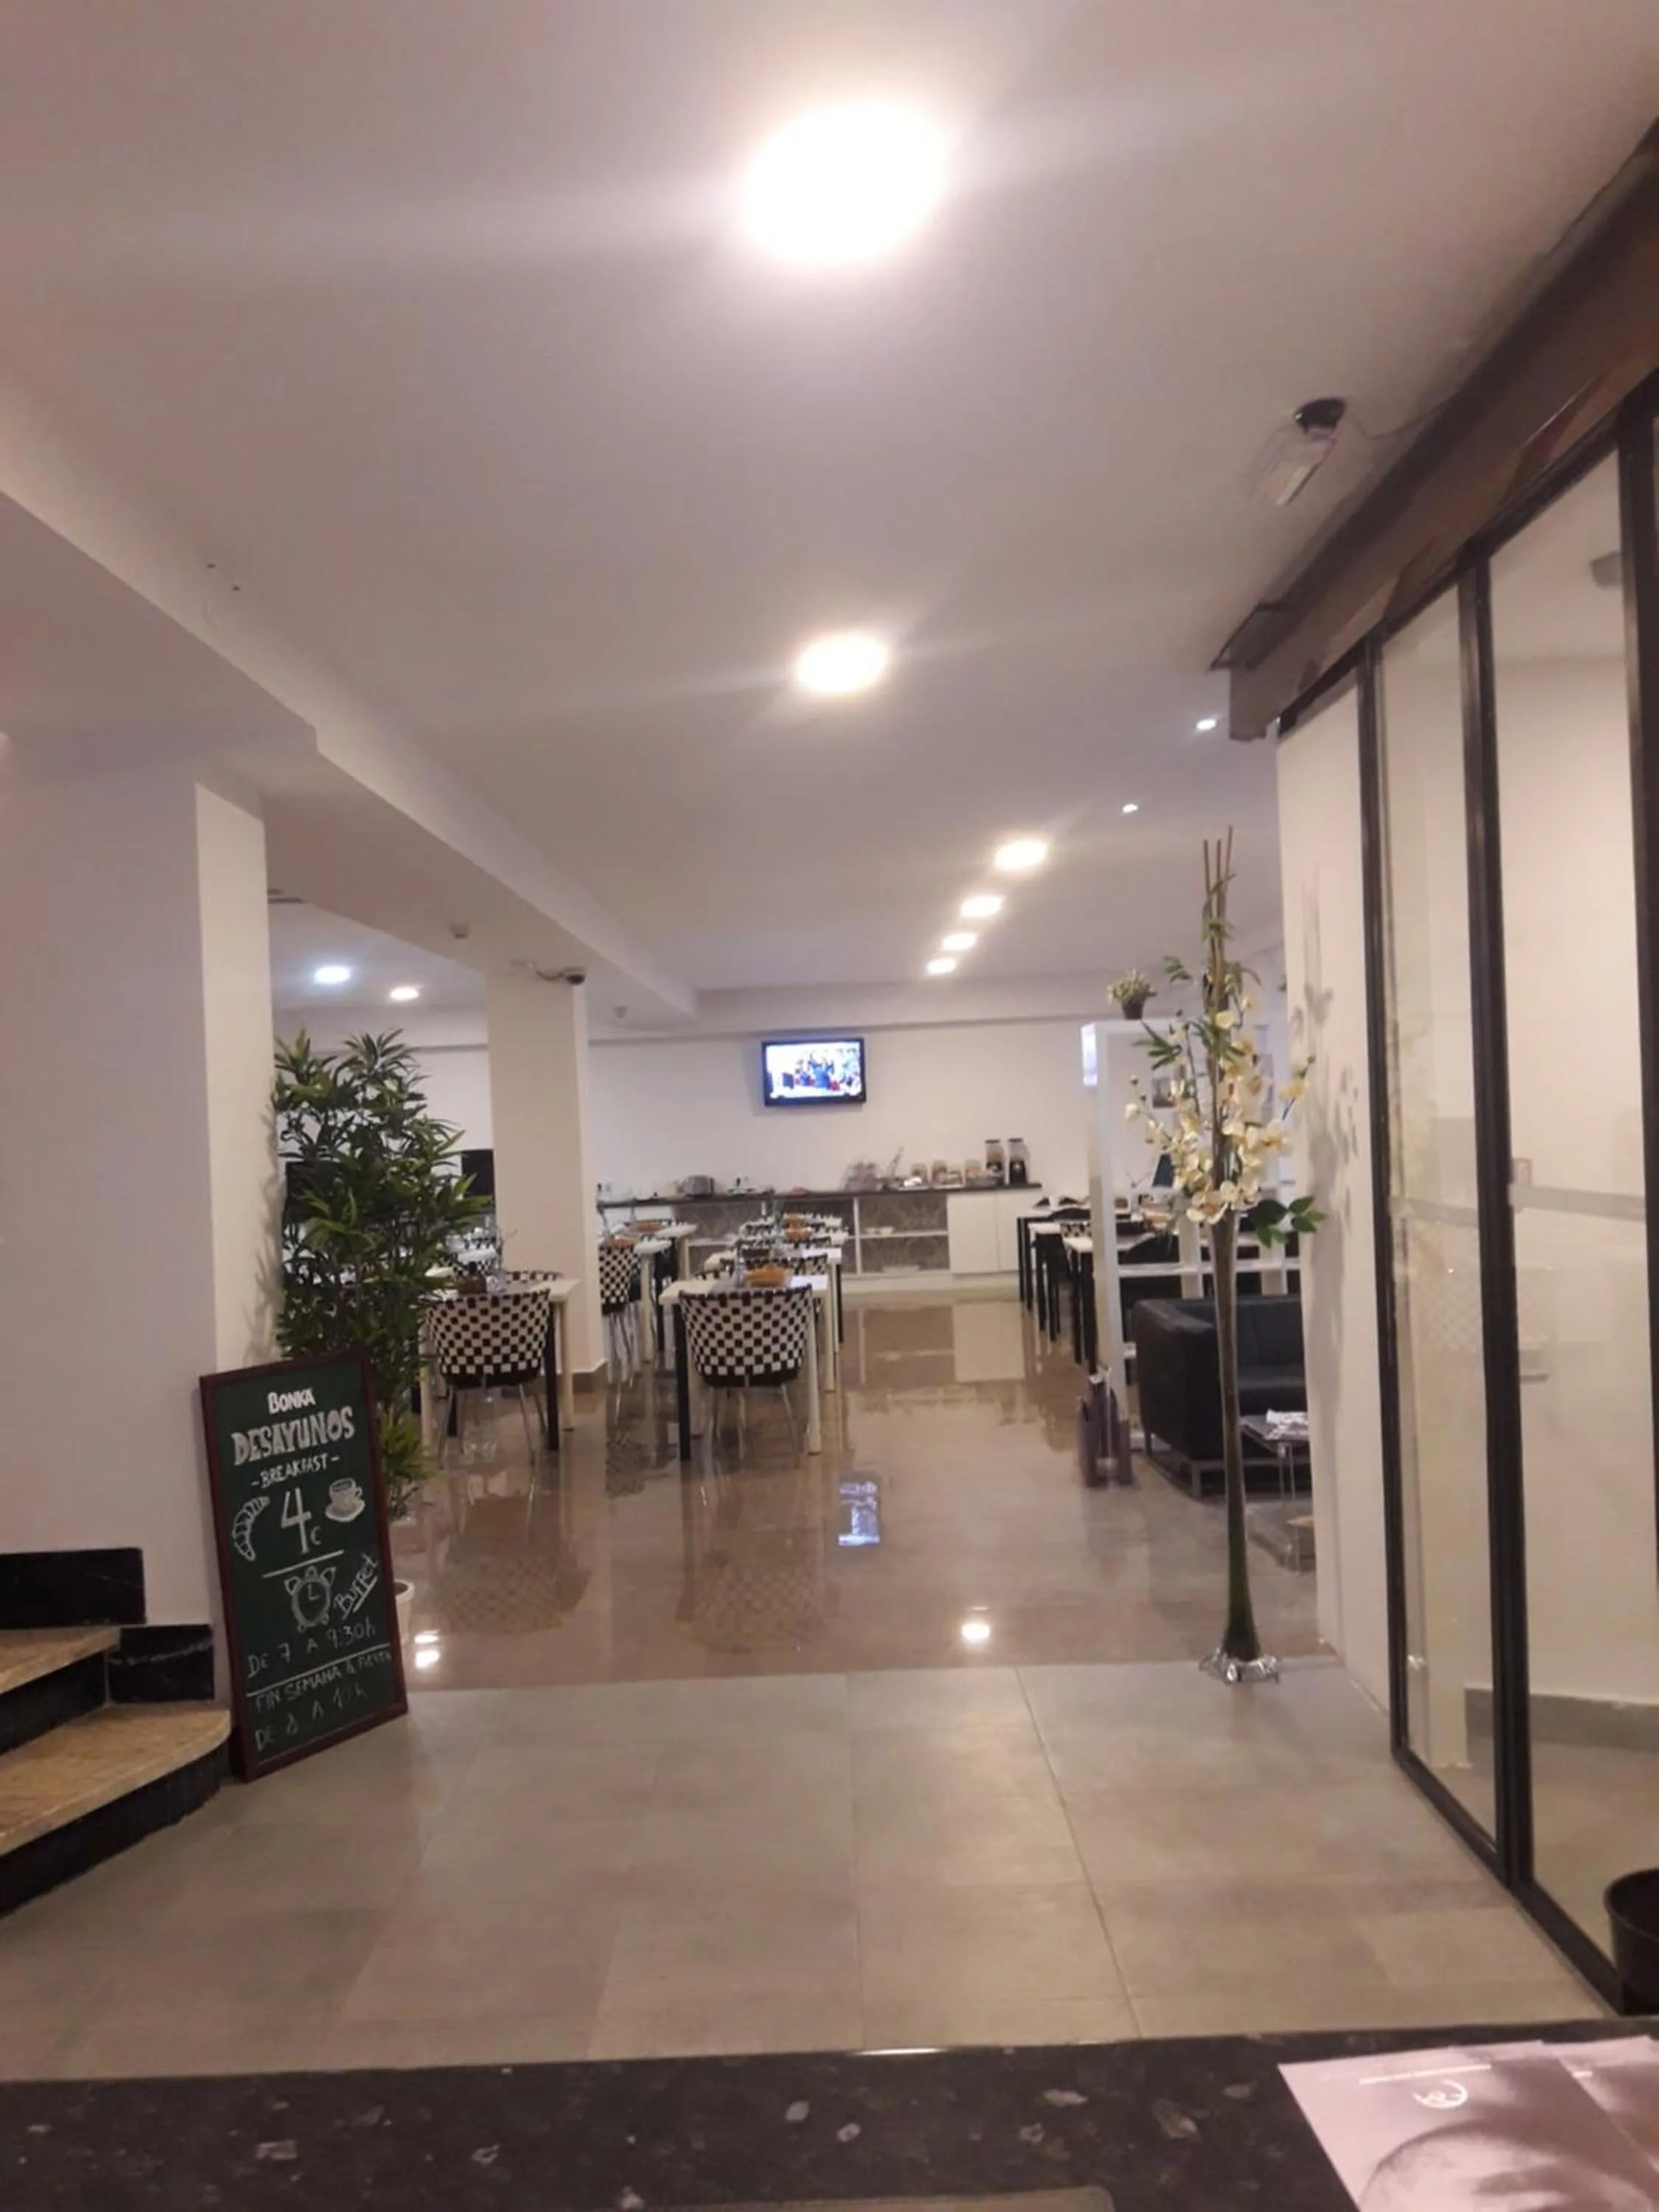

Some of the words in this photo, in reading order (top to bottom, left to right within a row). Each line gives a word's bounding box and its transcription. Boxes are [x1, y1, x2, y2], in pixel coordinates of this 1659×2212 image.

[268, 1388, 316, 1414] BONKA
[230, 1405, 355, 1466] DESAYUNOS
[248, 1653, 269, 1679] DE
[277, 1642, 291, 1663] 7
[306, 1638, 319, 1654] A
[285, 1666, 343, 1701] SEMANA
